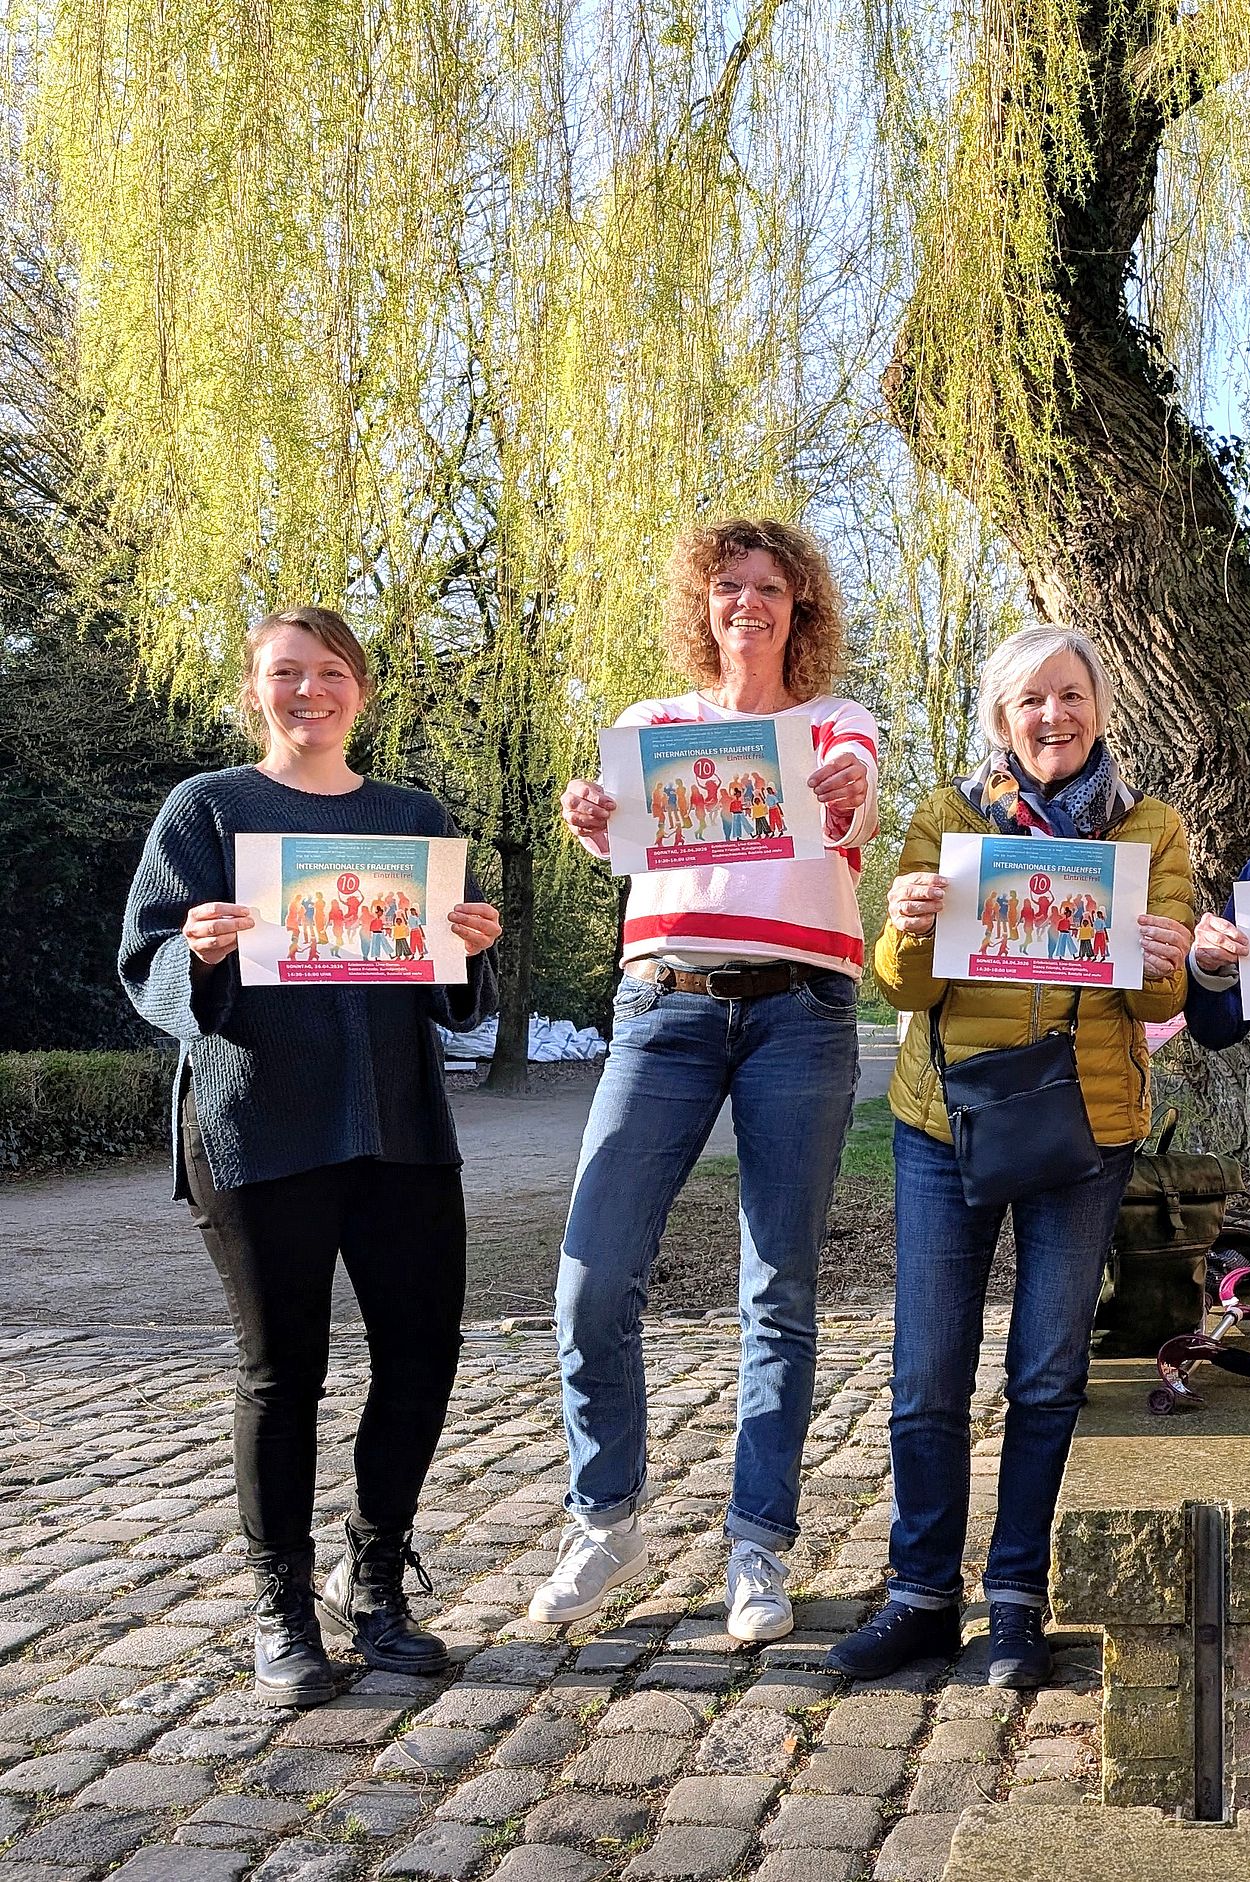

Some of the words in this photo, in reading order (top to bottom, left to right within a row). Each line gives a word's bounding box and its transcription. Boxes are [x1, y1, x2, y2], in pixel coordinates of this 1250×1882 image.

[654, 747, 718, 758] INTERNATIONALES
[720, 745, 764, 754] FRAUENFEST
[697, 762, 712, 775] 10
[993, 862, 1056, 871] INTERNATIONALES
[1058, 865, 1101, 873] FRAUENFEST
[341, 876, 356, 890] 10
[1033, 877, 1047, 891] 10
